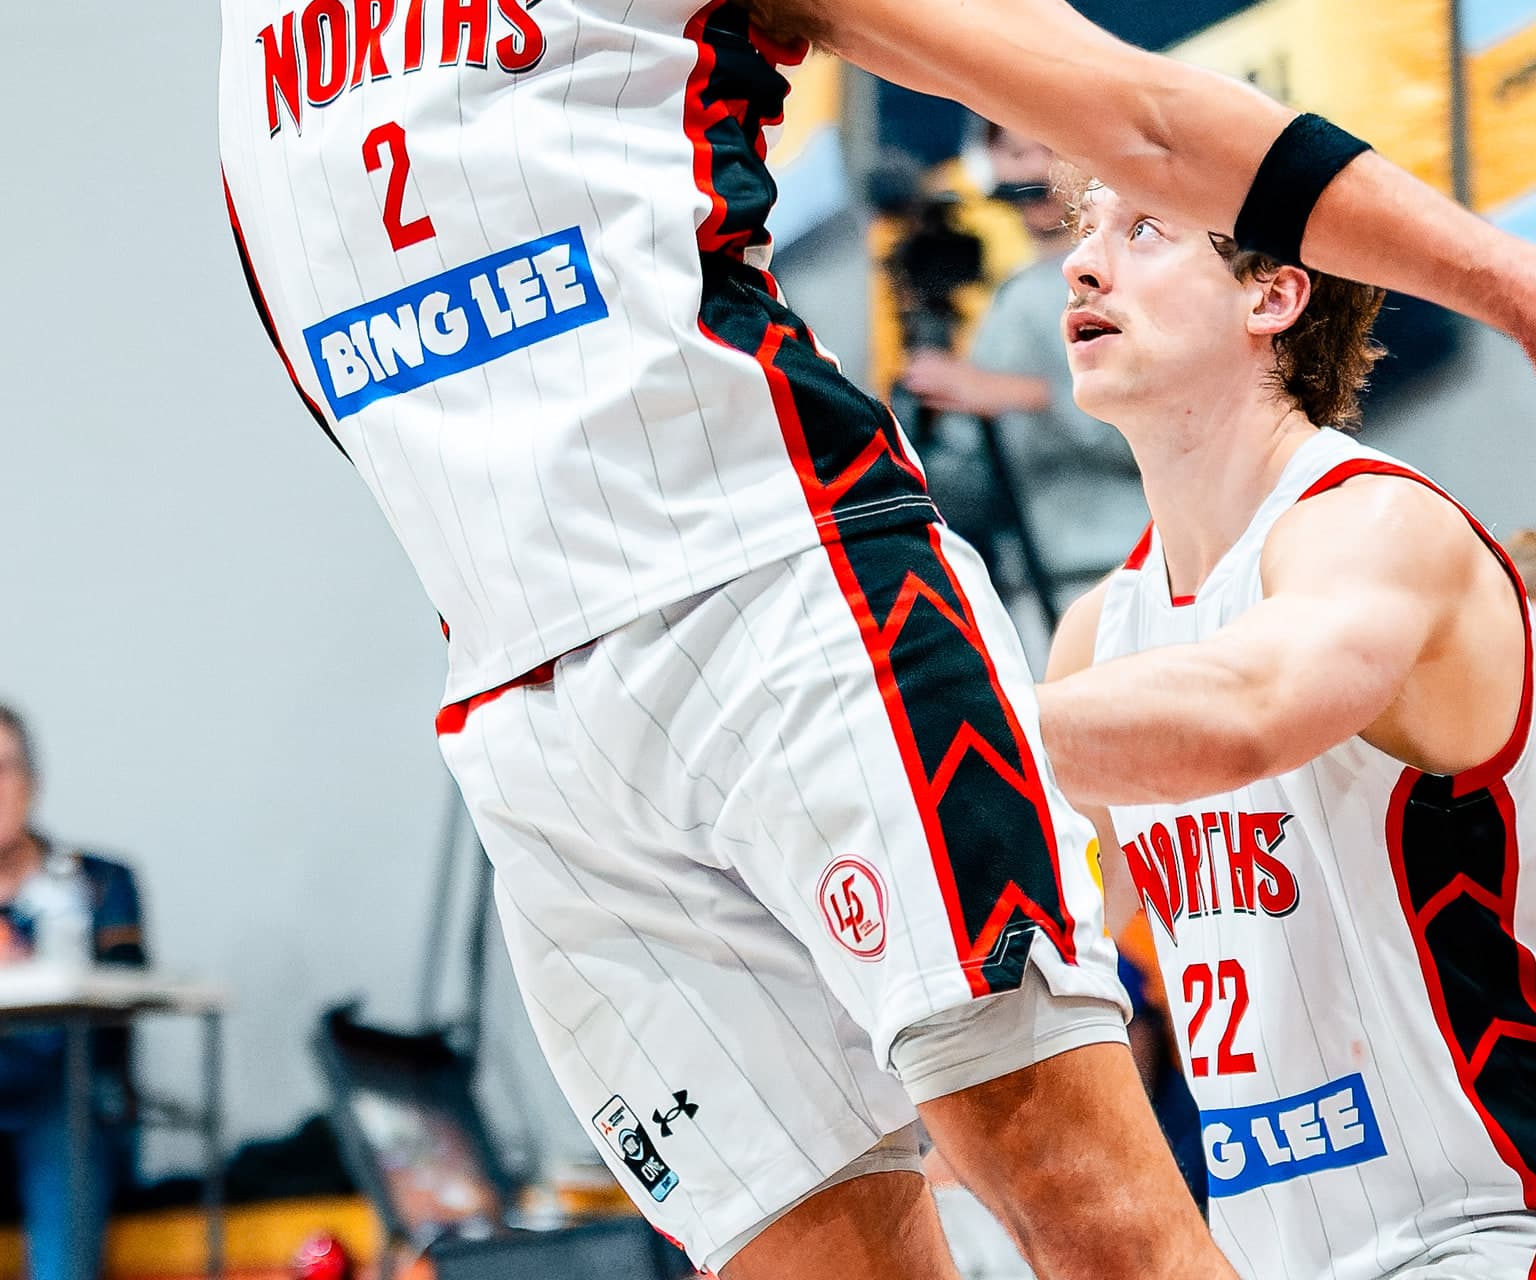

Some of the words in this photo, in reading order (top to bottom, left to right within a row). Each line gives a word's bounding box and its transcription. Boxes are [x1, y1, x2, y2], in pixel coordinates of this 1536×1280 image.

[363, 121, 437, 251] 2
[320, 287, 467, 399] BING
[470, 244, 588, 339] LEE
[1121, 811, 1300, 947] NORTHS
[1183, 959, 1257, 1077] 22
[1251, 1089, 1365, 1167] LEE
